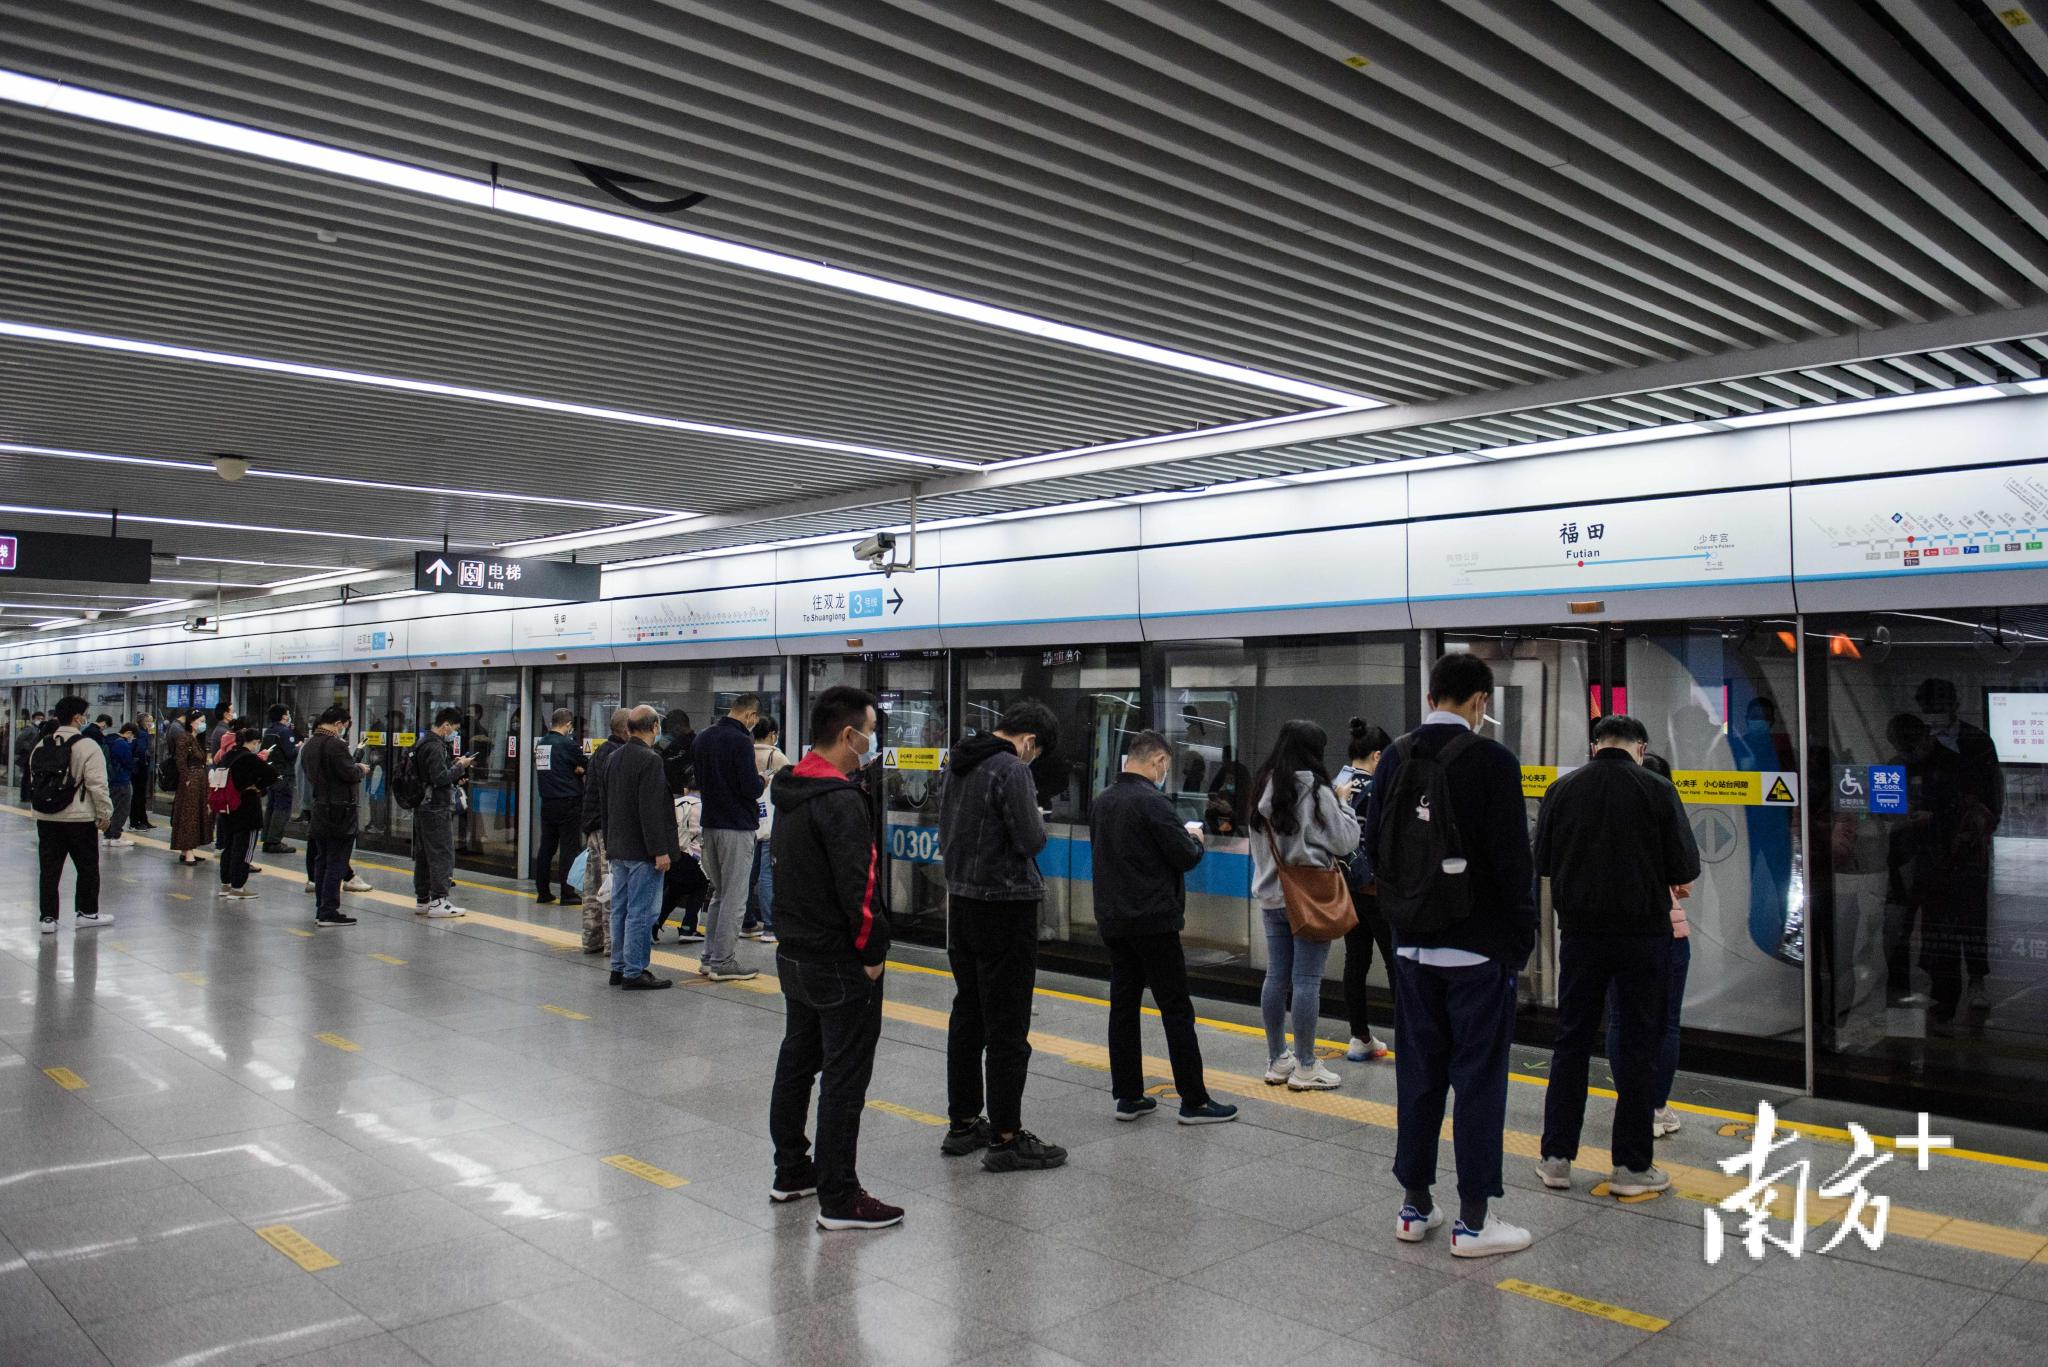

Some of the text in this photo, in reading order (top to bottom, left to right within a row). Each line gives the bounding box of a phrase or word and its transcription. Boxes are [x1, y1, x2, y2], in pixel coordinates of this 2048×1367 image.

[1560, 522, 1606, 545] 福田
[1698, 533, 1729, 545] 少年宫
[1566, 548, 1601, 560] Futian
[488, 563, 522, 582] 电梯
[487, 581, 504, 590] Lift
[812, 592, 846, 611] 往双龙
[854, 594, 863, 614] 3
[803, 612, 847, 623] To Shuanglong
[1873, 771, 1901, 785] 强冷
[893, 828, 944, 861] 0302
